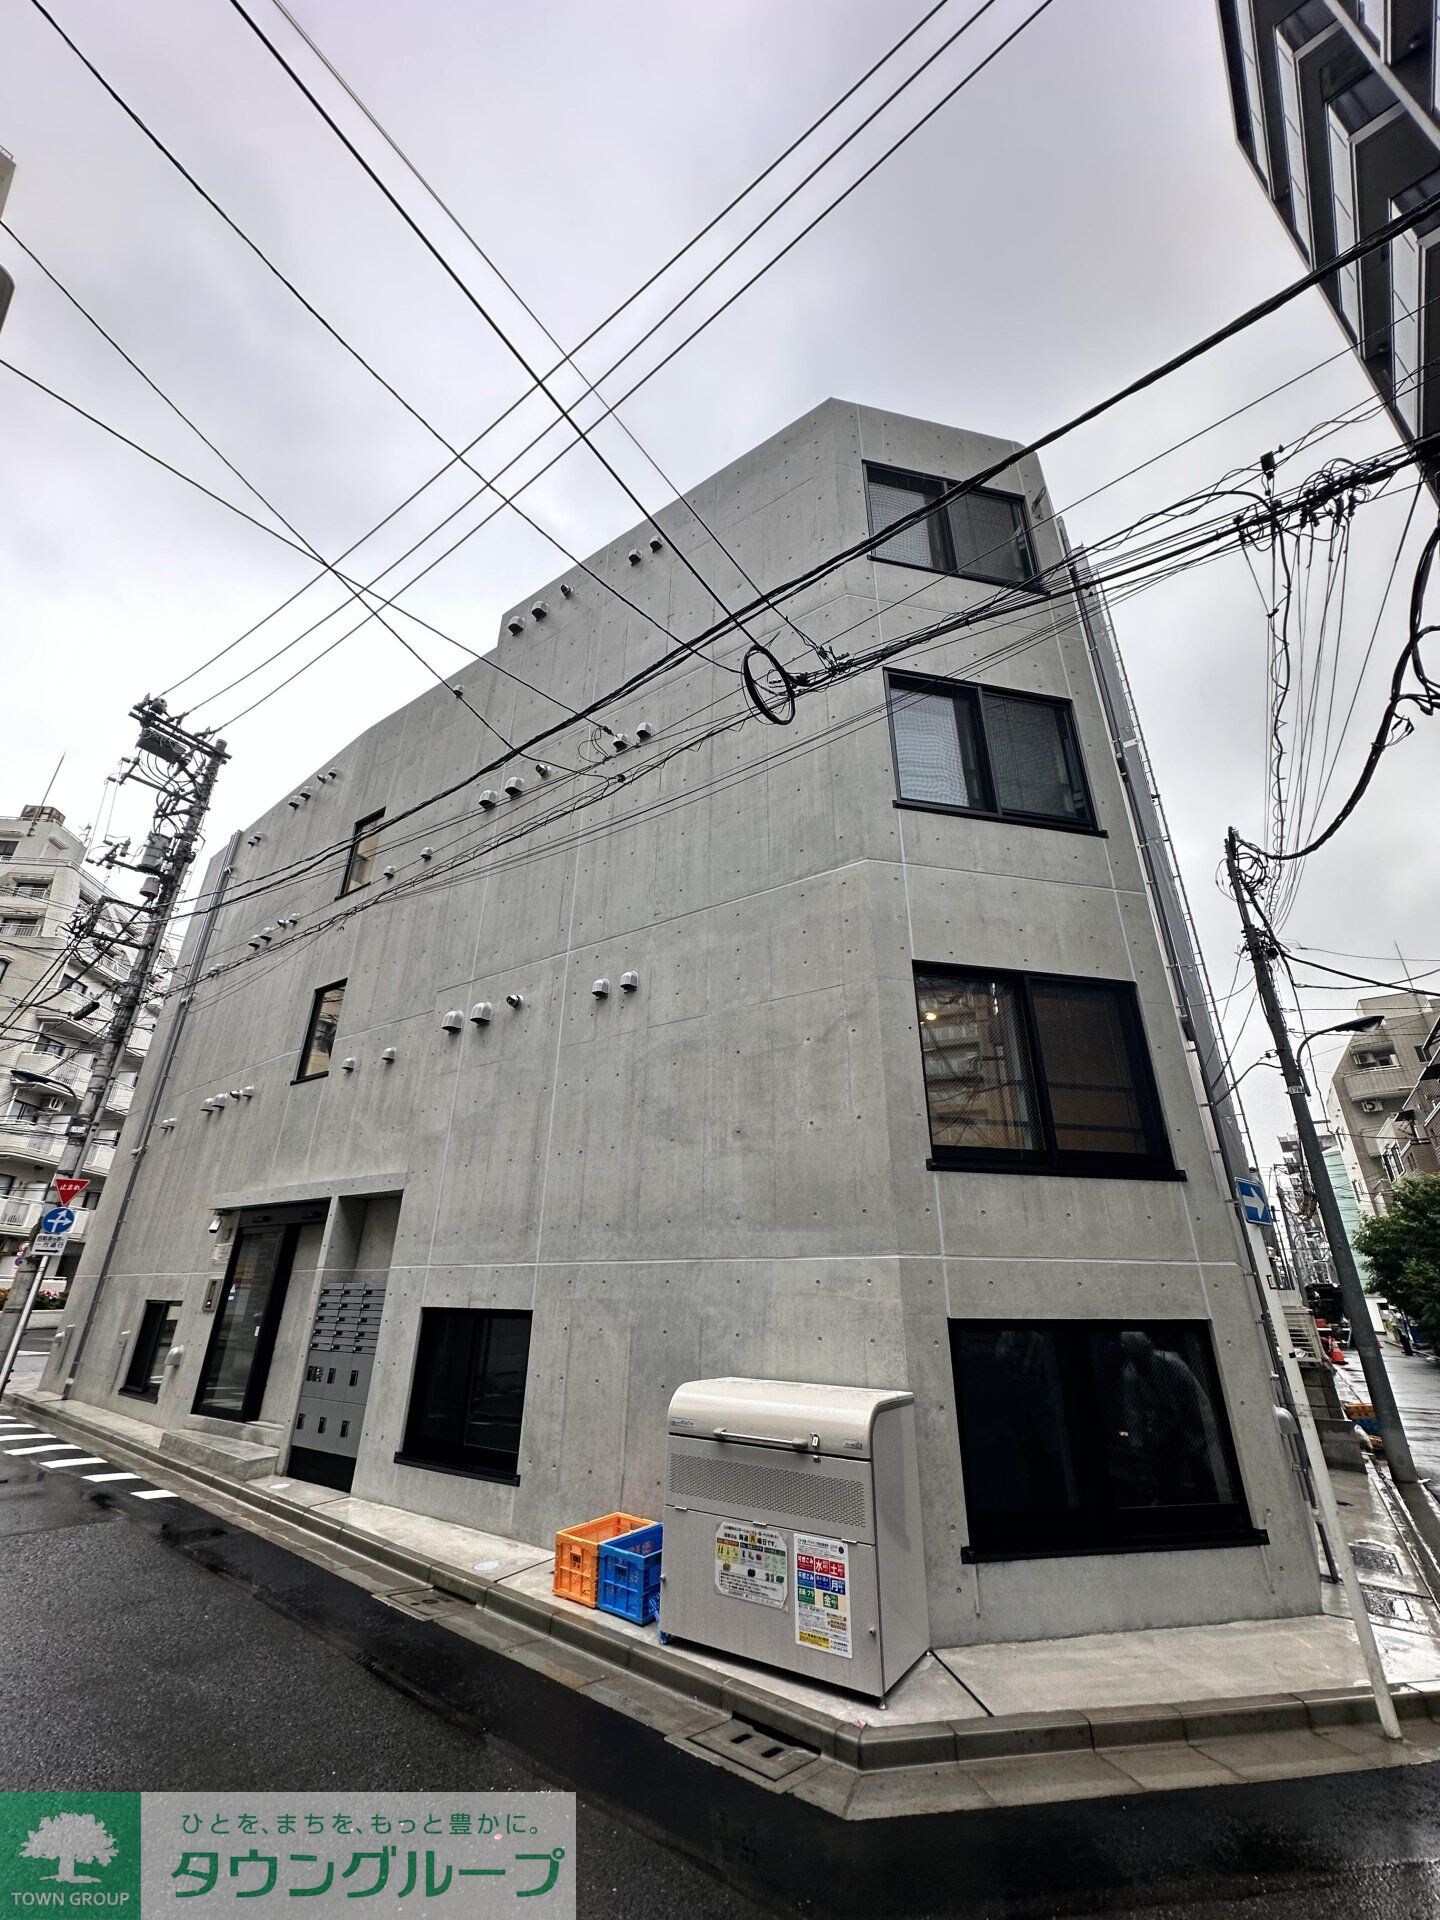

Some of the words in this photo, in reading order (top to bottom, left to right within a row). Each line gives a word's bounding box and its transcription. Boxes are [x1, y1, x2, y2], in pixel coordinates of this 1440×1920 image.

[816, 1560, 823, 1572] 水
[831, 1564, 838, 1575] 土
[831, 1579, 838, 1591] 月
[823, 1595, 831, 1607] 金
